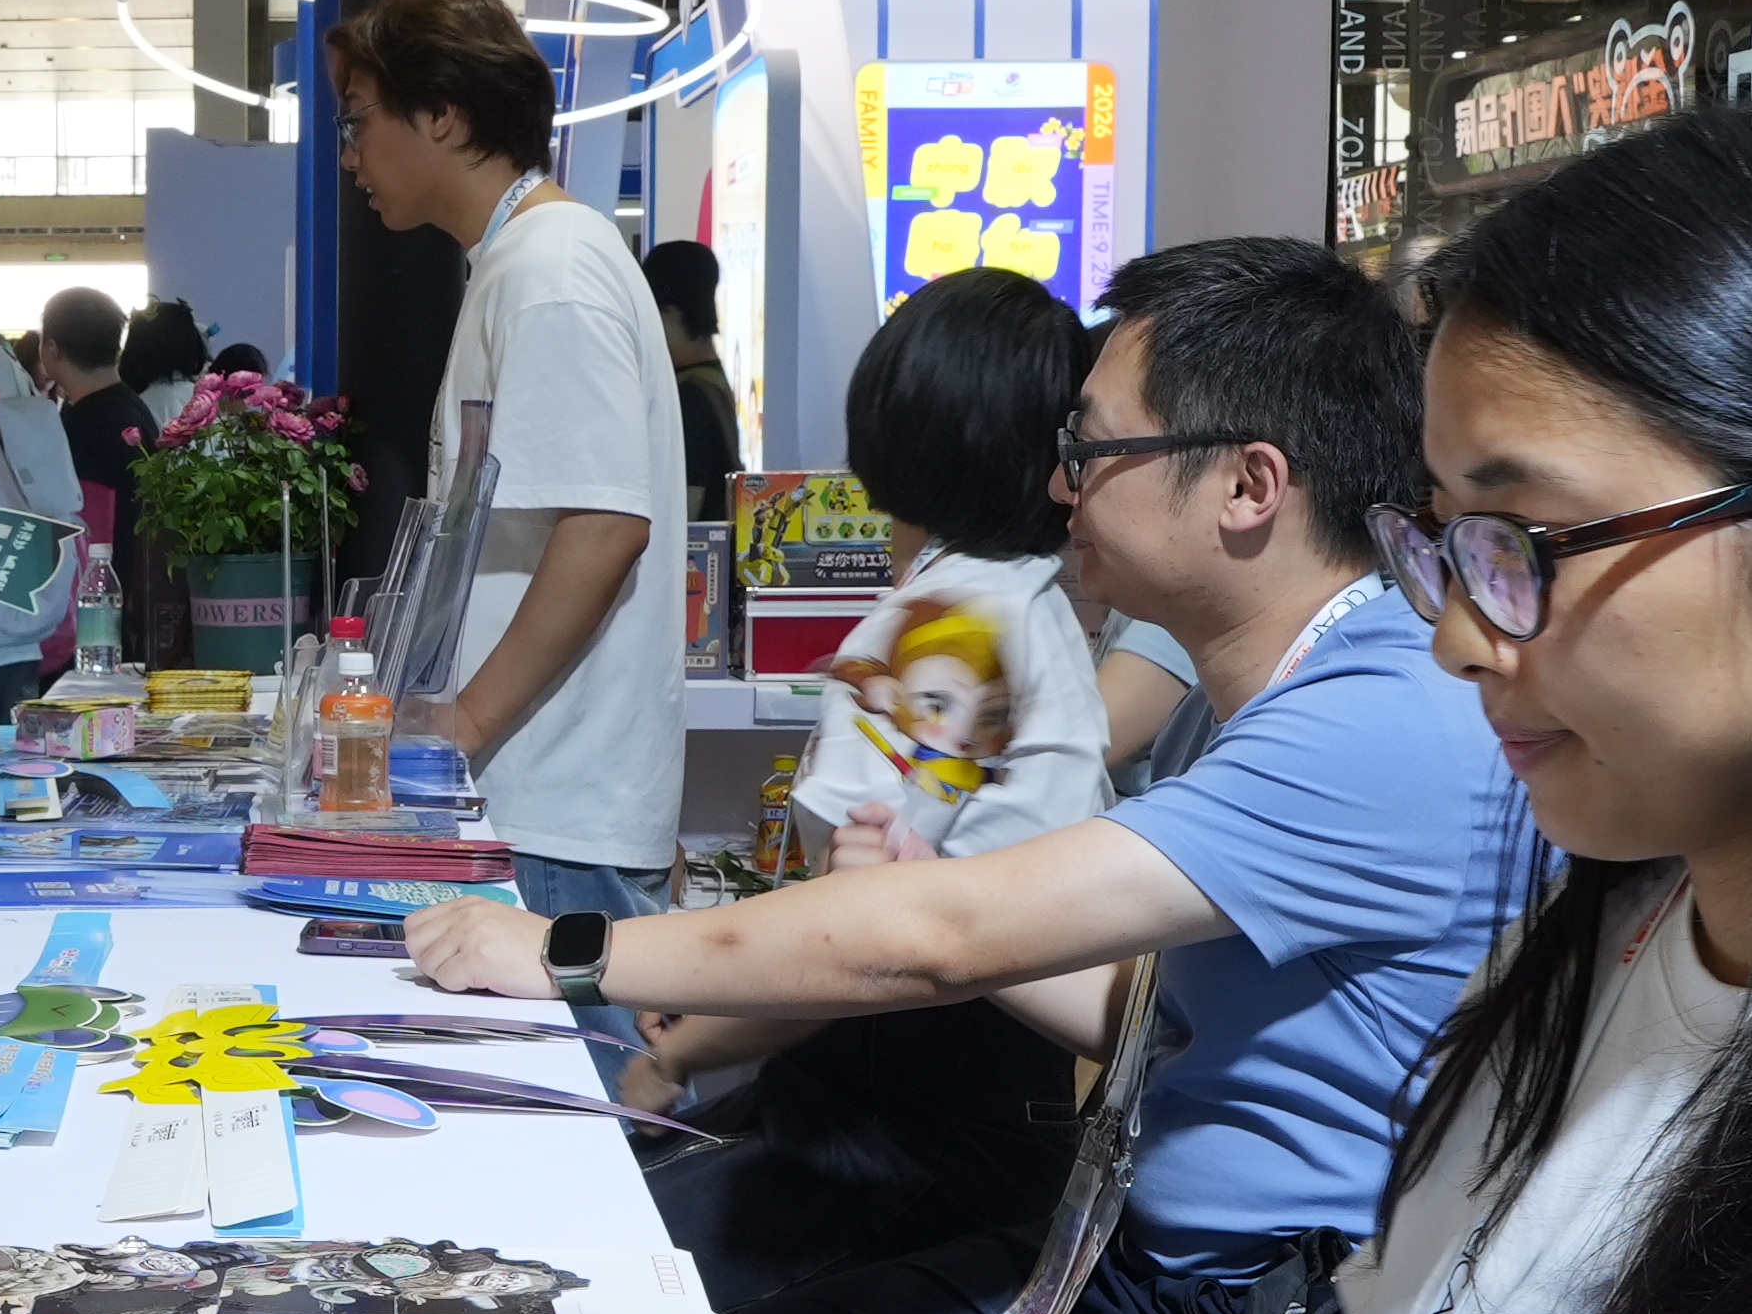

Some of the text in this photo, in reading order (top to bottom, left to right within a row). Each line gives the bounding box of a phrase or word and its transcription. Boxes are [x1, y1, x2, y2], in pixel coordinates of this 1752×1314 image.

[1093, 83, 1114, 139] 2026
[860, 90, 878, 170] FAMILY
[926, 161, 969, 175] zhong
[1012, 162, 1033, 174] qiu
[932, 241, 953, 252] hai
[1010, 241, 1032, 252] fun
[685, 657, 712, 666] 下西洋
